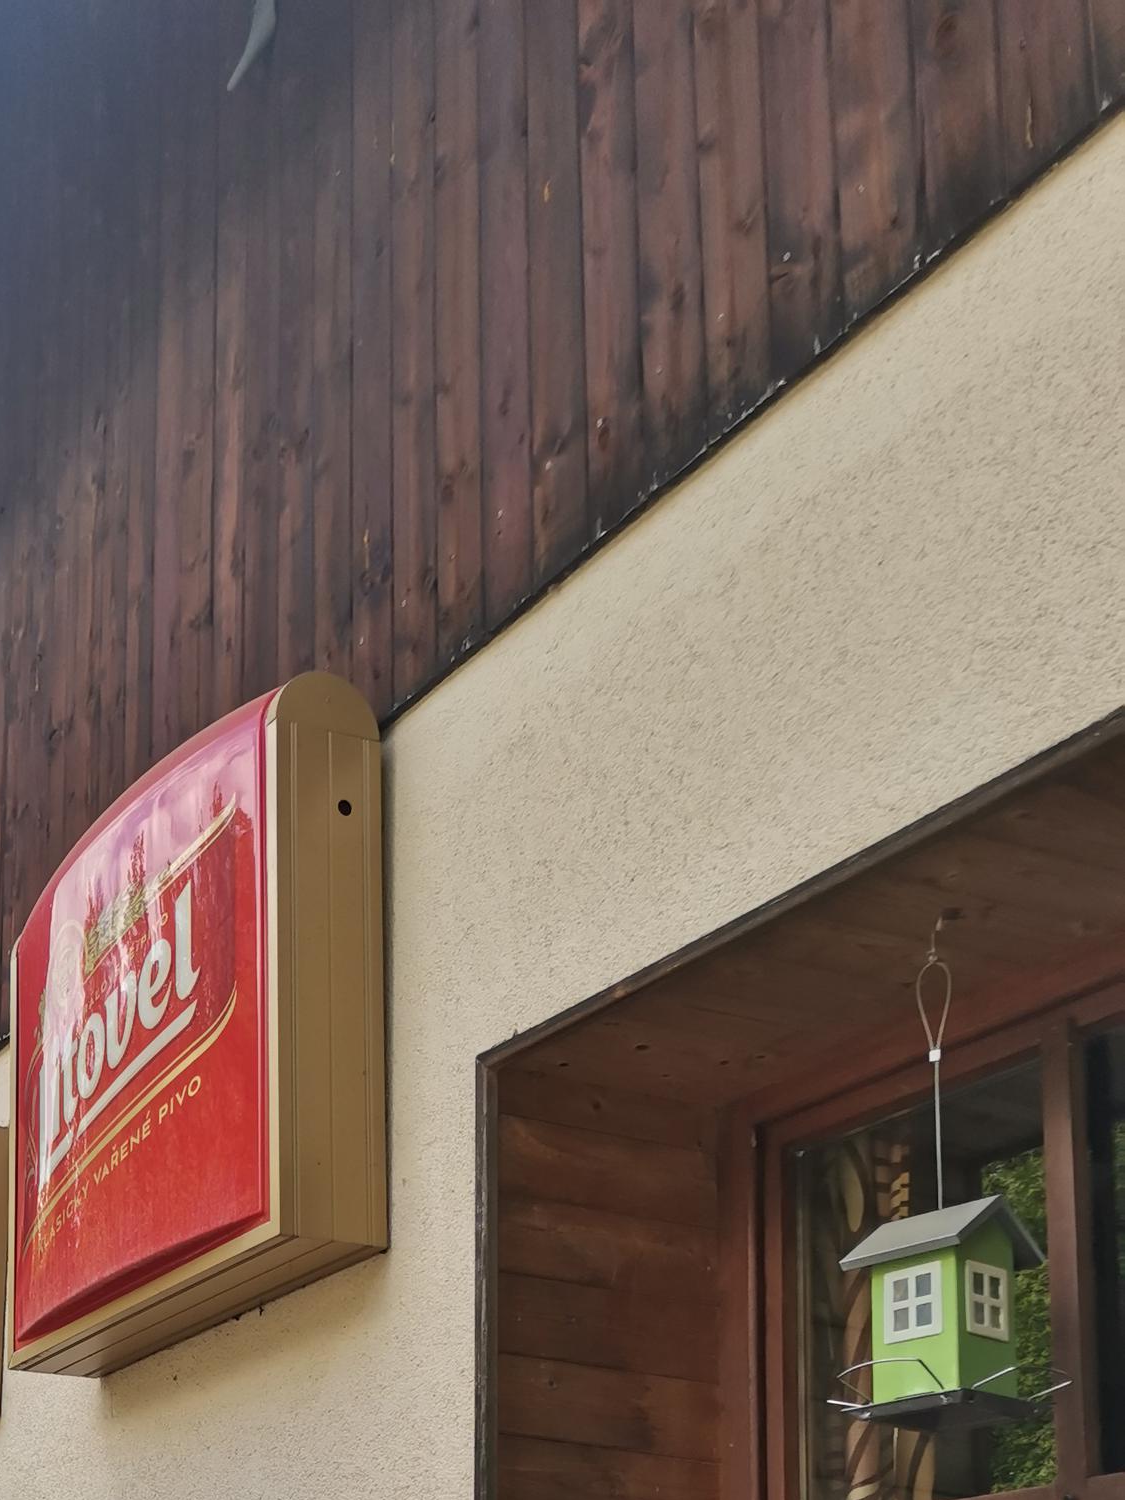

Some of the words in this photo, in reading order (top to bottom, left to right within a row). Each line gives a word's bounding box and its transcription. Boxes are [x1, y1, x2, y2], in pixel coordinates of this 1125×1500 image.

[38, 883, 201, 1194] Litovel
[93, 1110, 152, 1185] VAŘENÉ
[158, 1075, 202, 1124] PIVO
